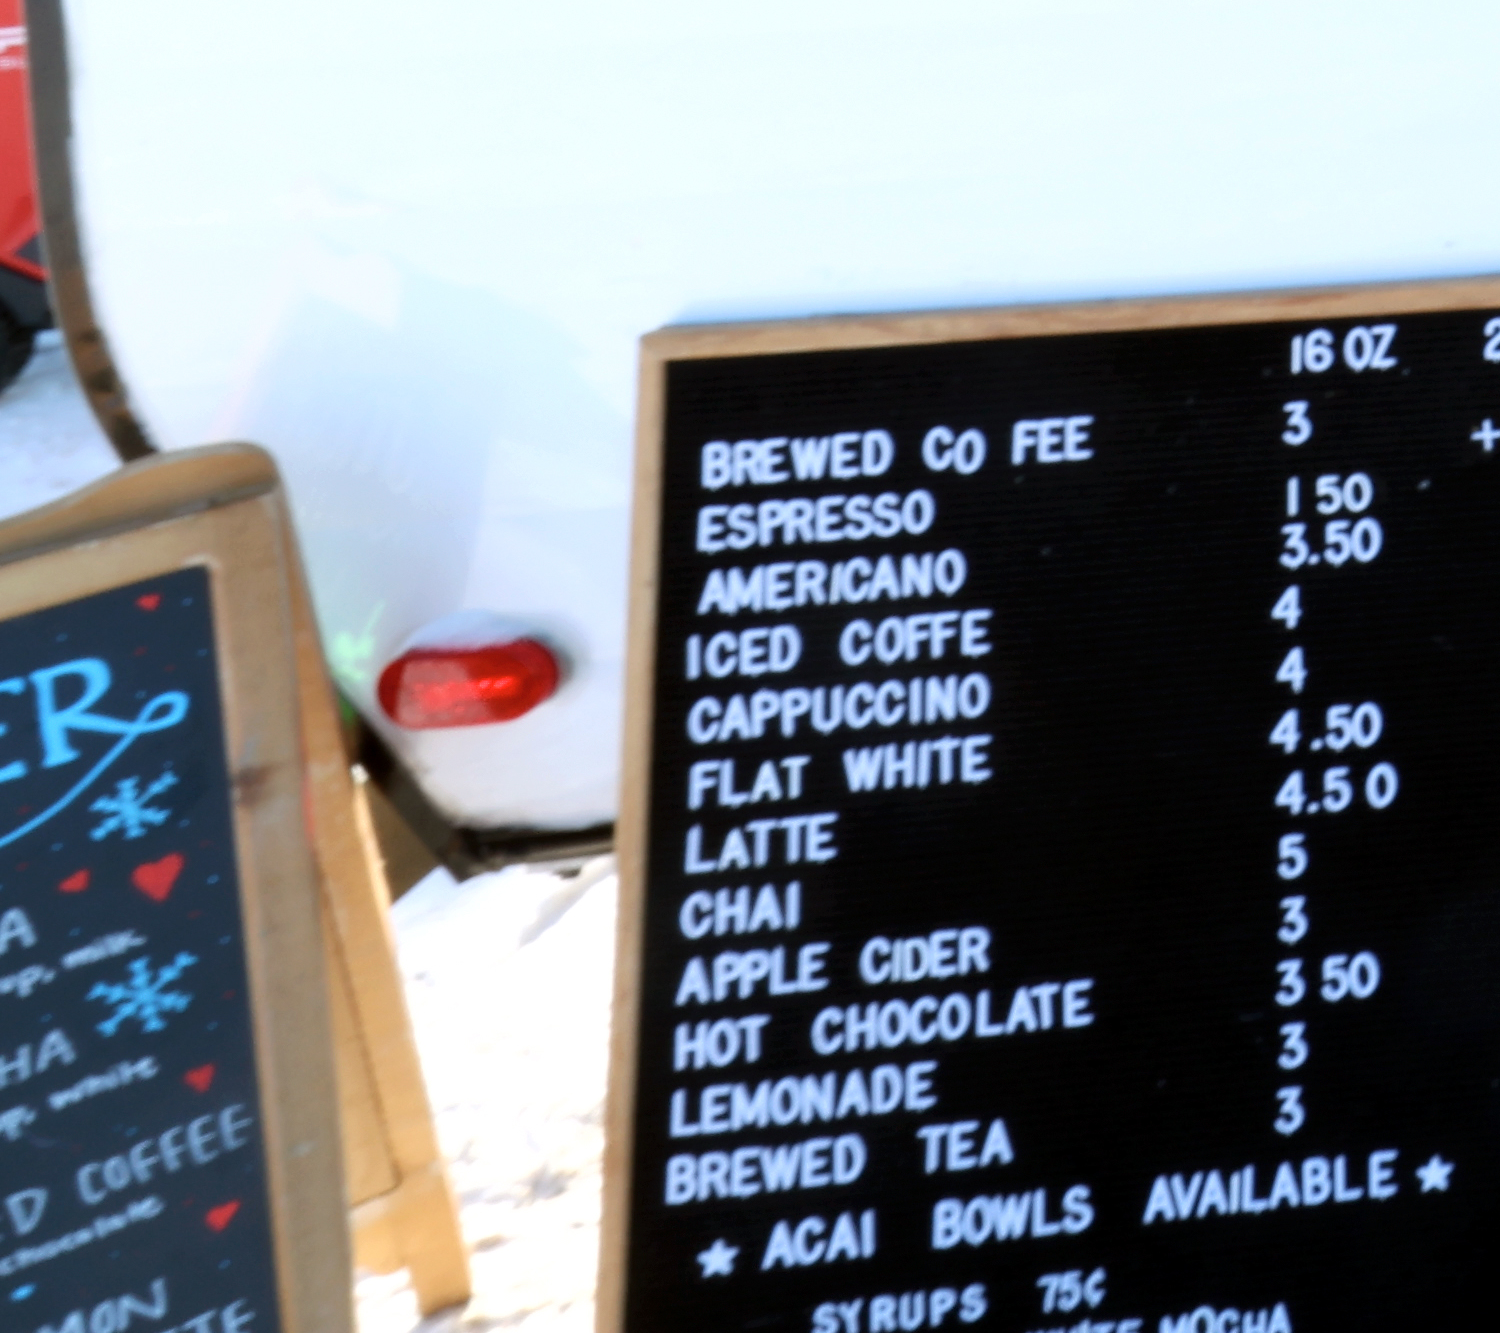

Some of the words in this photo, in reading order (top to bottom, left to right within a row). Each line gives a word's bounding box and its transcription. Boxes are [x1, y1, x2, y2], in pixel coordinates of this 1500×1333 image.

[1290, 329, 1336, 374] 16
[1343, 323, 1398, 372] OZ
[1281, 399, 1313, 446] 3
[702, 428, 895, 490] BREWED
[696, 488, 936, 554] ESPRESSO
[1278, 517, 1384, 570] 3.50
[697, 547, 968, 617] AMERICANO
[1270, 584, 1304, 630] 4
[685, 624, 803, 681] ICED
[838, 608, 994, 667] COFFE
[1274, 645, 1309, 695] 4
[686, 671, 992, 745] CAPPUCCINO
[687, 755, 812, 811] FLAT
[842, 734, 993, 793] WHITE
[684, 812, 840, 874] LATTE
[1276, 832, 1309, 880] 5
[678, 879, 802, 940] CHAI
[1276, 894, 1310, 945] 3
[674, 941, 831, 1007] APPLE
[858, 925, 992, 986] CIDER
[672, 1014, 771, 1072] HOT
[810, 979, 1096, 1056] CHOCOLATE
[1276, 1020, 1310, 1071] 3
[669, 1060, 940, 1138] LEMONADE
[1273, 1084, 1306, 1136] 3
[75, 1103, 254, 1206] COFFEE
[664, 1133, 868, 1207] BREWED
[916, 1117, 1015, 1176] TEA
[760, 1208, 877, 1272] ACAI
[930, 1184, 1096, 1251] BOWLS
[1141, 1148, 1400, 1226] AVAILABLE
[810, 1282, 988, 1333] SYRUPS
[1035, 1265, 1107, 1315] 75¢
